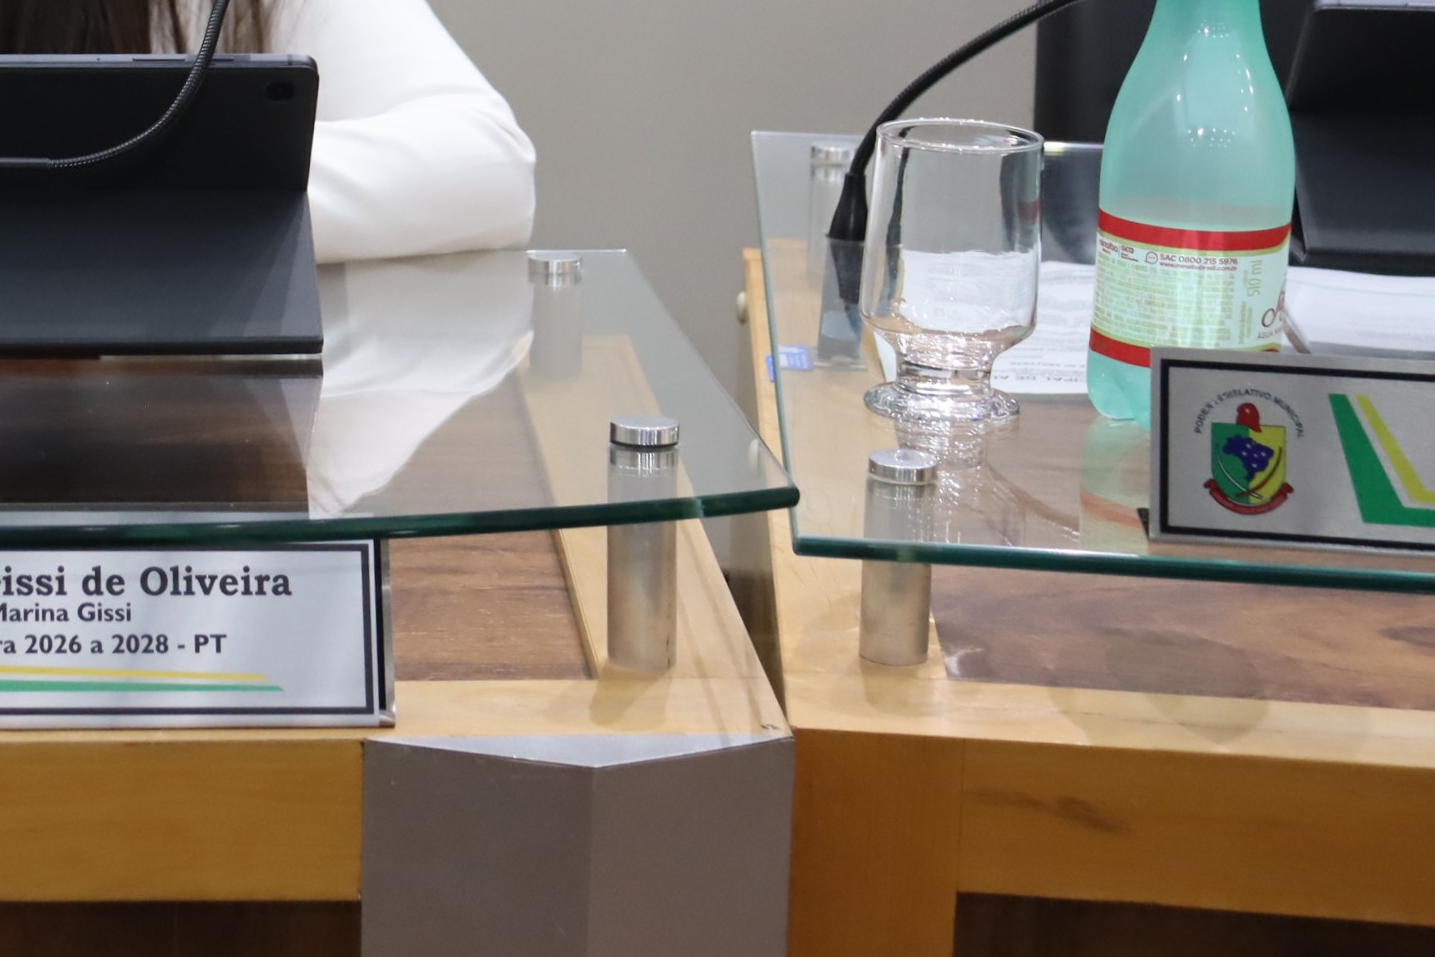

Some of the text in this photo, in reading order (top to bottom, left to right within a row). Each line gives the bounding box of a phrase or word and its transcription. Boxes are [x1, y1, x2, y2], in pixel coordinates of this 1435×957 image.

[1160, 253, 1177, 262] SAC
[1178, 255, 1201, 264] 0800
[1203, 257, 1217, 265] 215
[1194, 388, 1305, 439] PODER LEGISLATIVO MUNICIPAL
[81, 565, 126, 596] de
[140, 565, 293, 596] Oliveira
[77, 602, 132, 622] Gissi
[24, 634, 82, 654] 2026
[90, 640, 104, 654] a
[111, 634, 169, 654] 2028
[194, 634, 227, 653] PT
